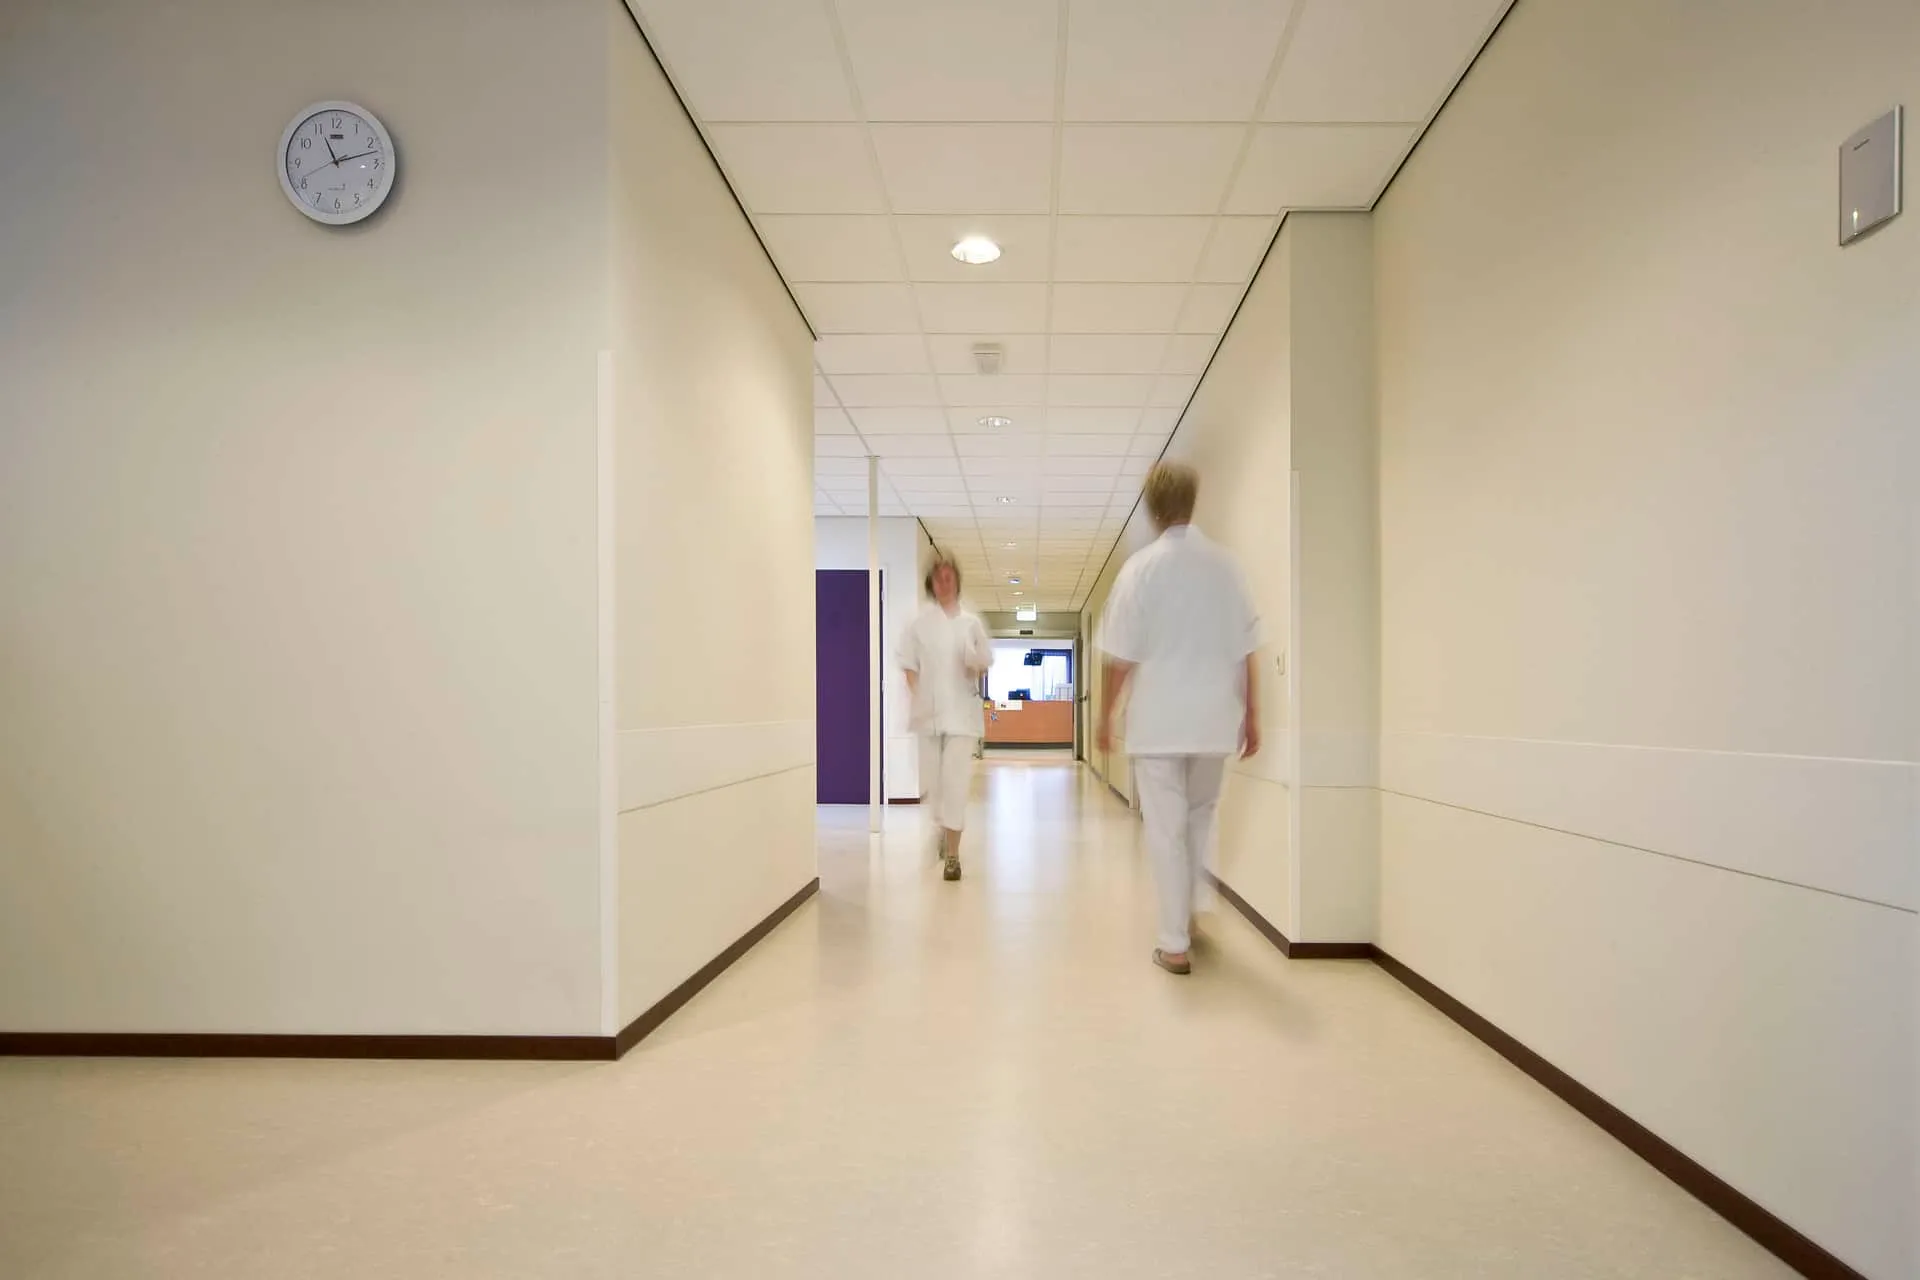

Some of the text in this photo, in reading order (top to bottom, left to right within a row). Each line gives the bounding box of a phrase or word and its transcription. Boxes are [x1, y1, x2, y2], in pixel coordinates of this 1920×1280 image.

[315, 123, 322, 135] 11
[331, 118, 342, 129] 12
[301, 138, 311, 149] 10
[367, 137, 374, 148] 2
[295, 158, 301, 168] 9
[373, 158, 379, 169] 3
[301, 176, 307, 189] 8
[367, 178, 373, 189] 4
[316, 192, 321, 203] 7
[354, 193, 360, 204] 5
[335, 198, 340, 209] 6
